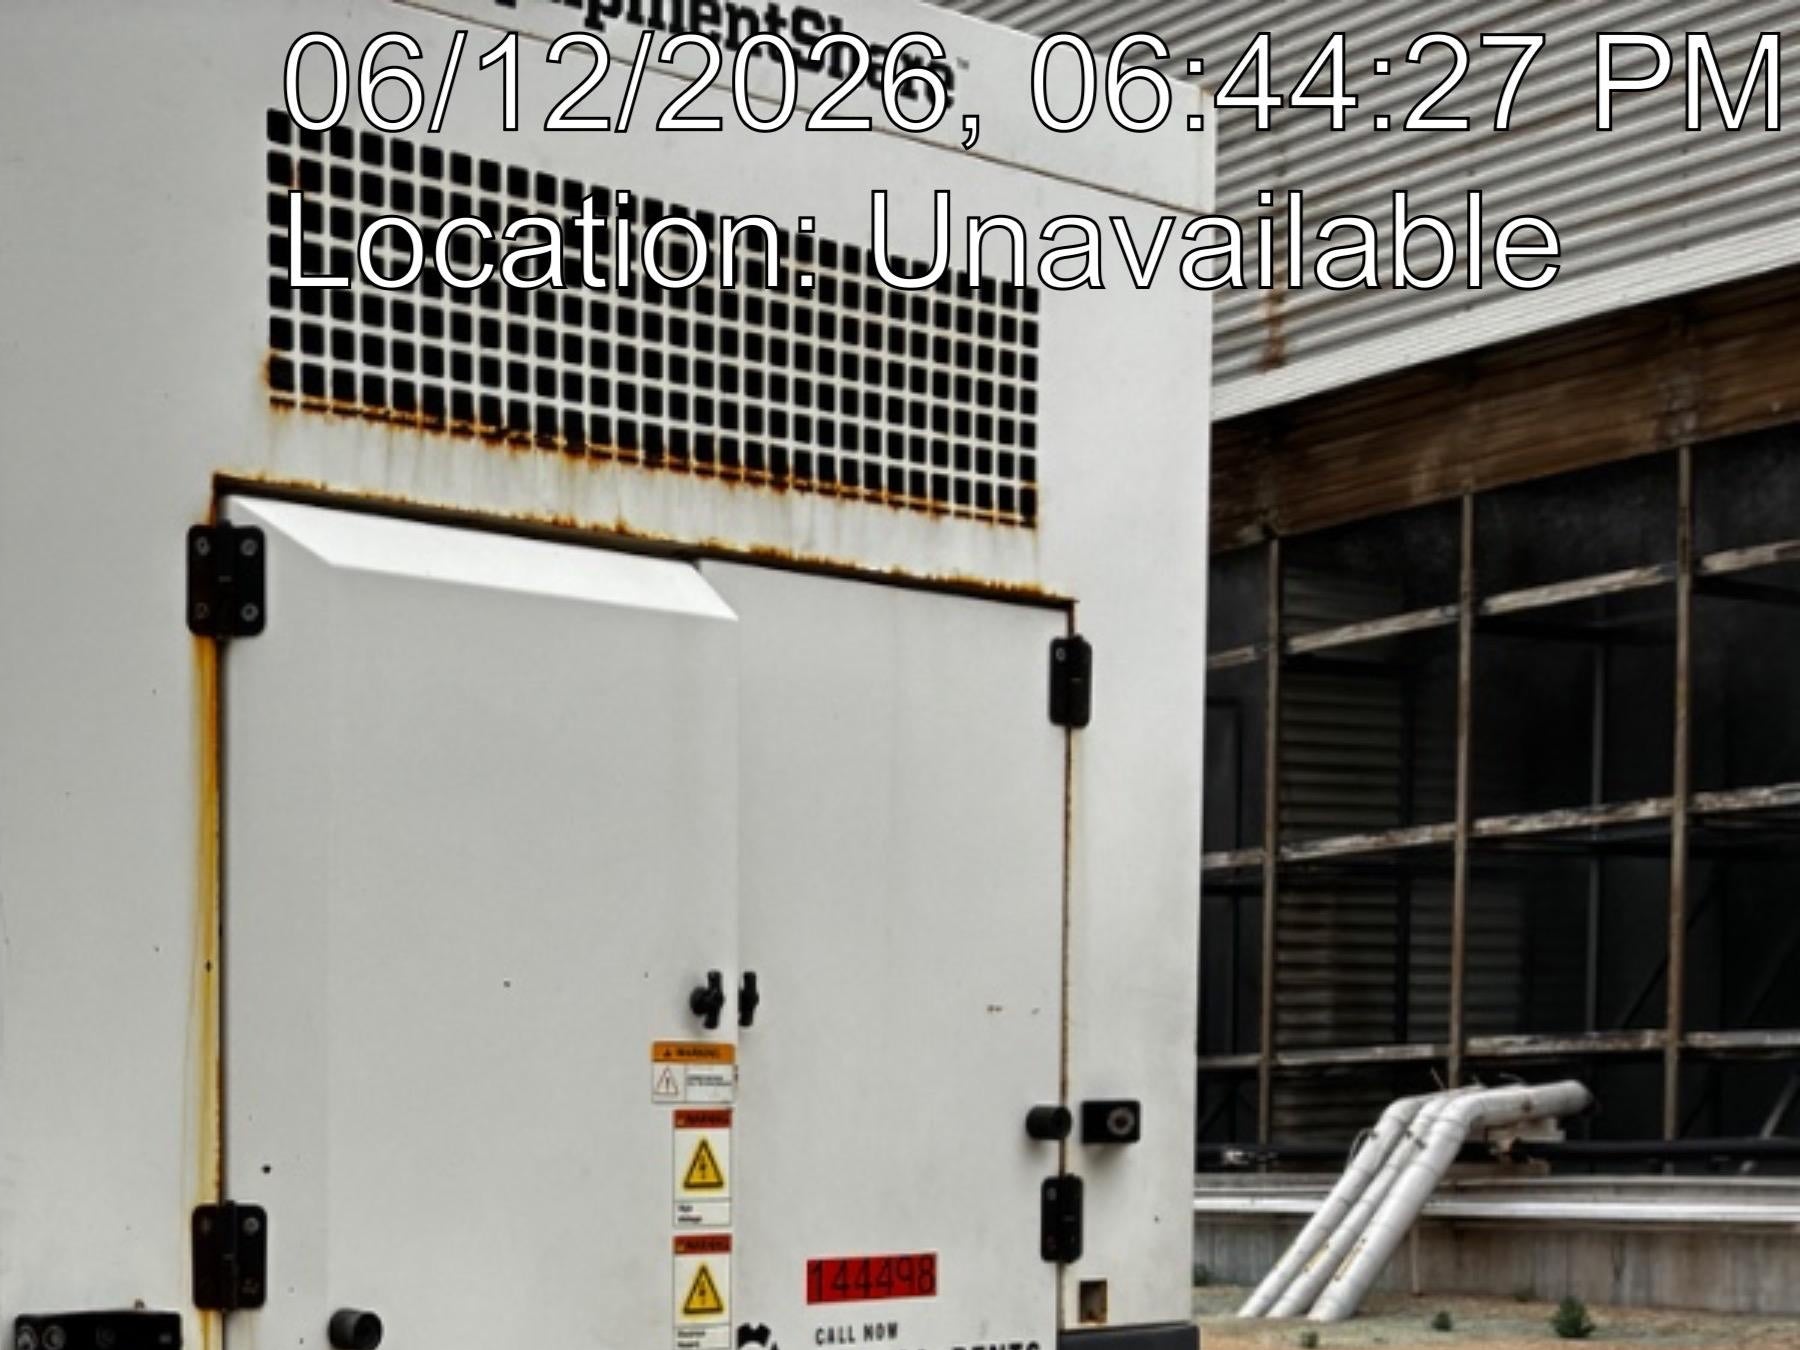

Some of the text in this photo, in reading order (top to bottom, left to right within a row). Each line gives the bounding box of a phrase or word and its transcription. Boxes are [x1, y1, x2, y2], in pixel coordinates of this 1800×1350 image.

[807, 1253, 938, 1303] 144498
[814, 1321, 899, 1347] CALL NOW
